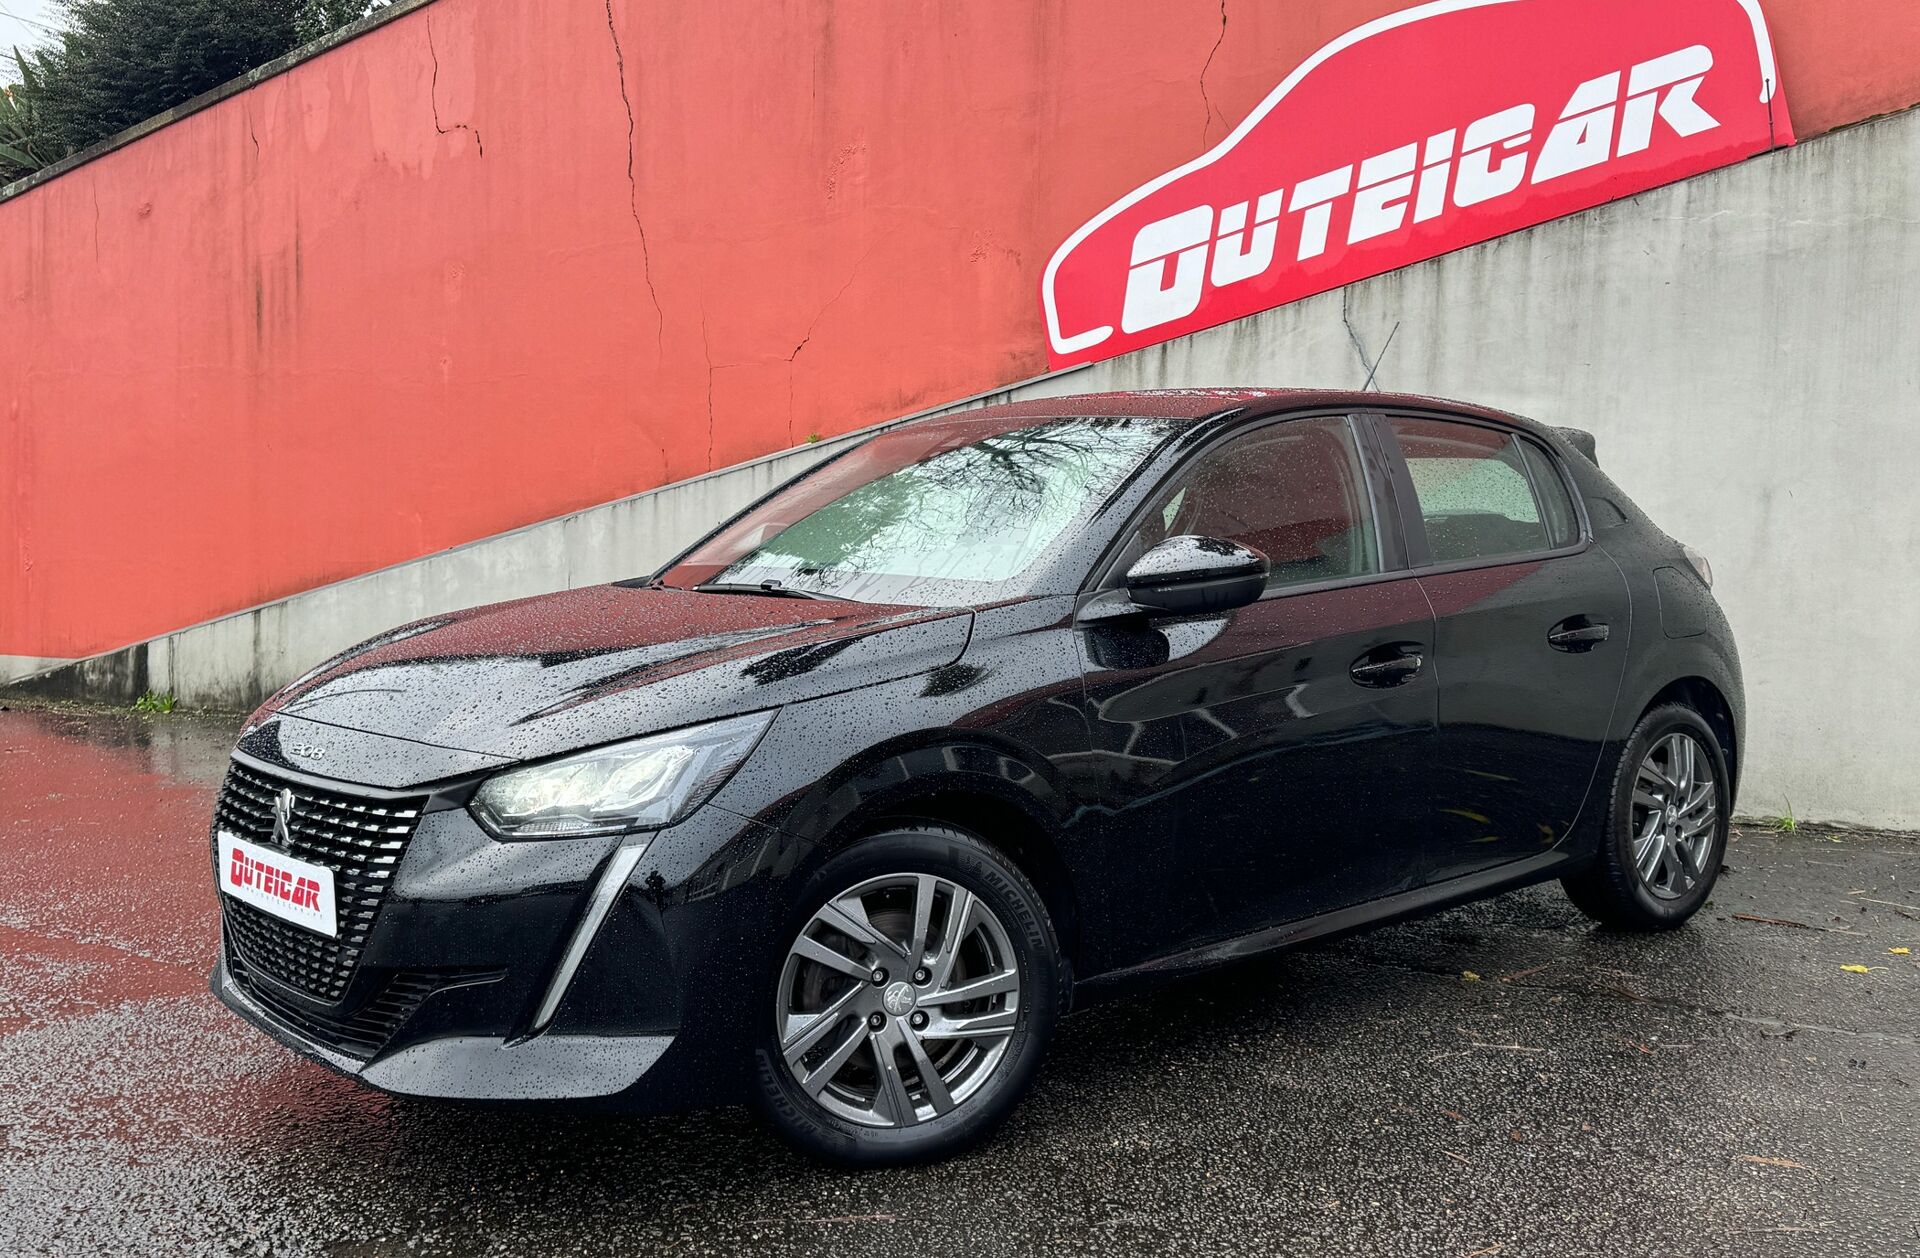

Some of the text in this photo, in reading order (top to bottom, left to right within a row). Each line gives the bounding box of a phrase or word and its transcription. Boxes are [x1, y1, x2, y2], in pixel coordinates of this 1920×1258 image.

[1121, 44, 1721, 335] OUTEICAR
[290, 742, 325, 760] 208
[230, 847, 321, 913] OUTEICAR
[984, 870, 1045, 950] MICHELIN
